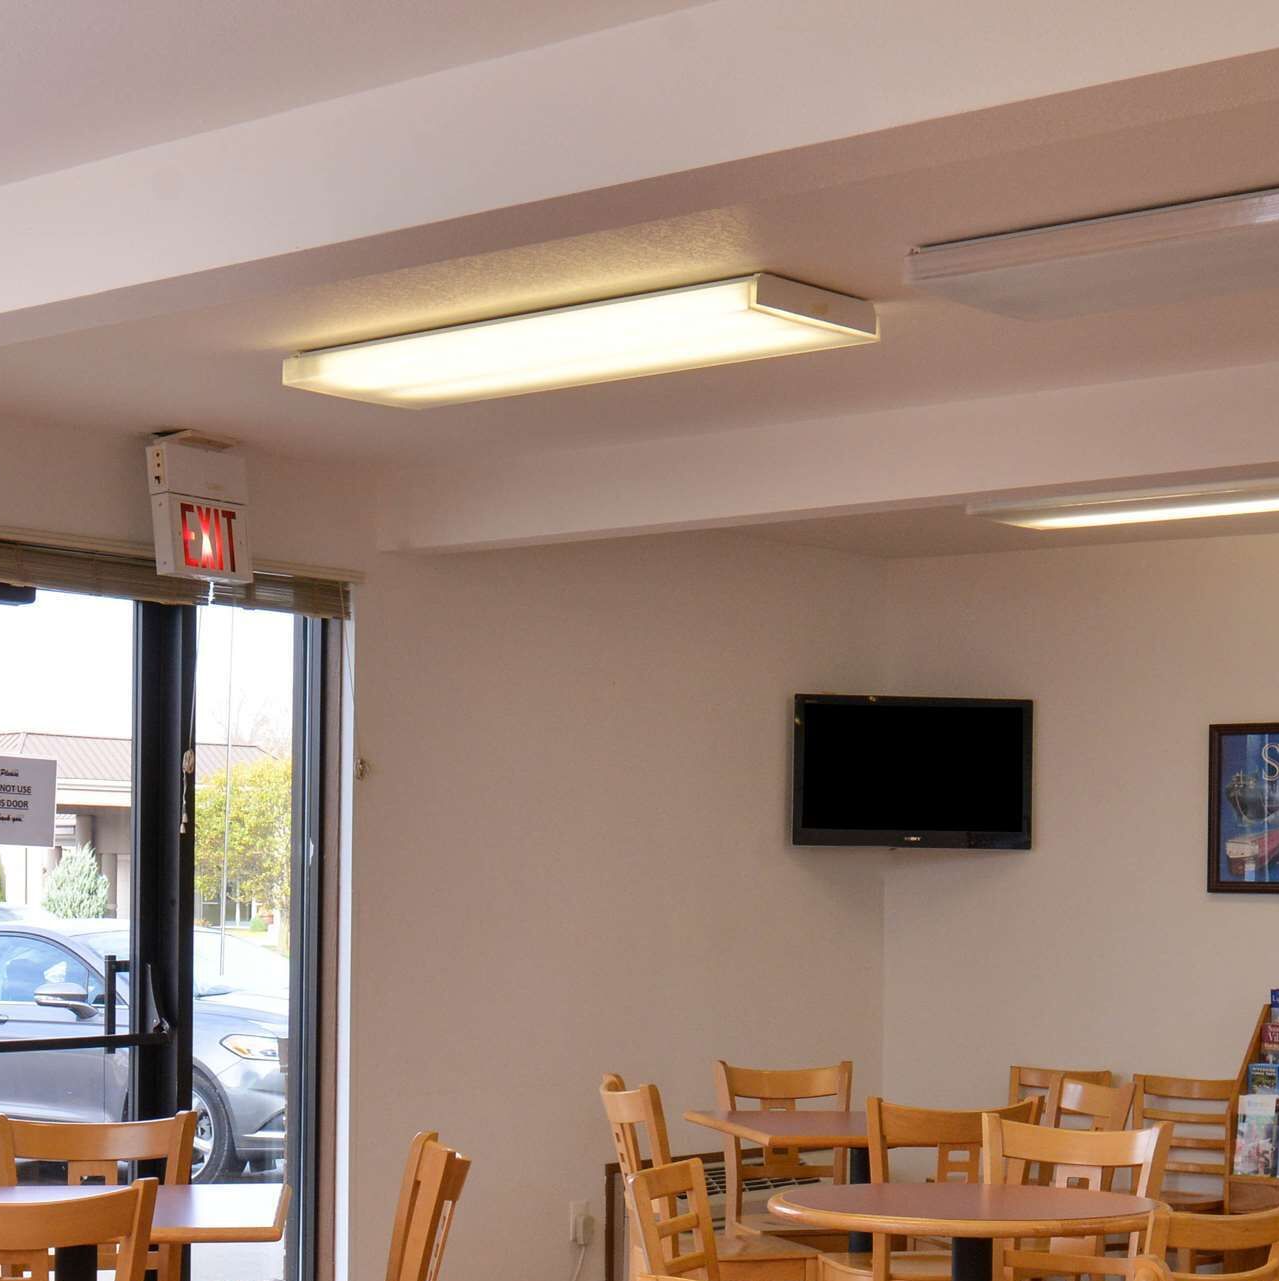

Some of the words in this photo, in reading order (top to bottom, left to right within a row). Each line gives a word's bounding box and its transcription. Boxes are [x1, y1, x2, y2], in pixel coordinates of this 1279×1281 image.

[180, 502, 237, 572] EXIT
[0, 784, 16, 793] NOT
[17, 785, 32, 794] USE
[7, 799, 29, 809] DOOR
